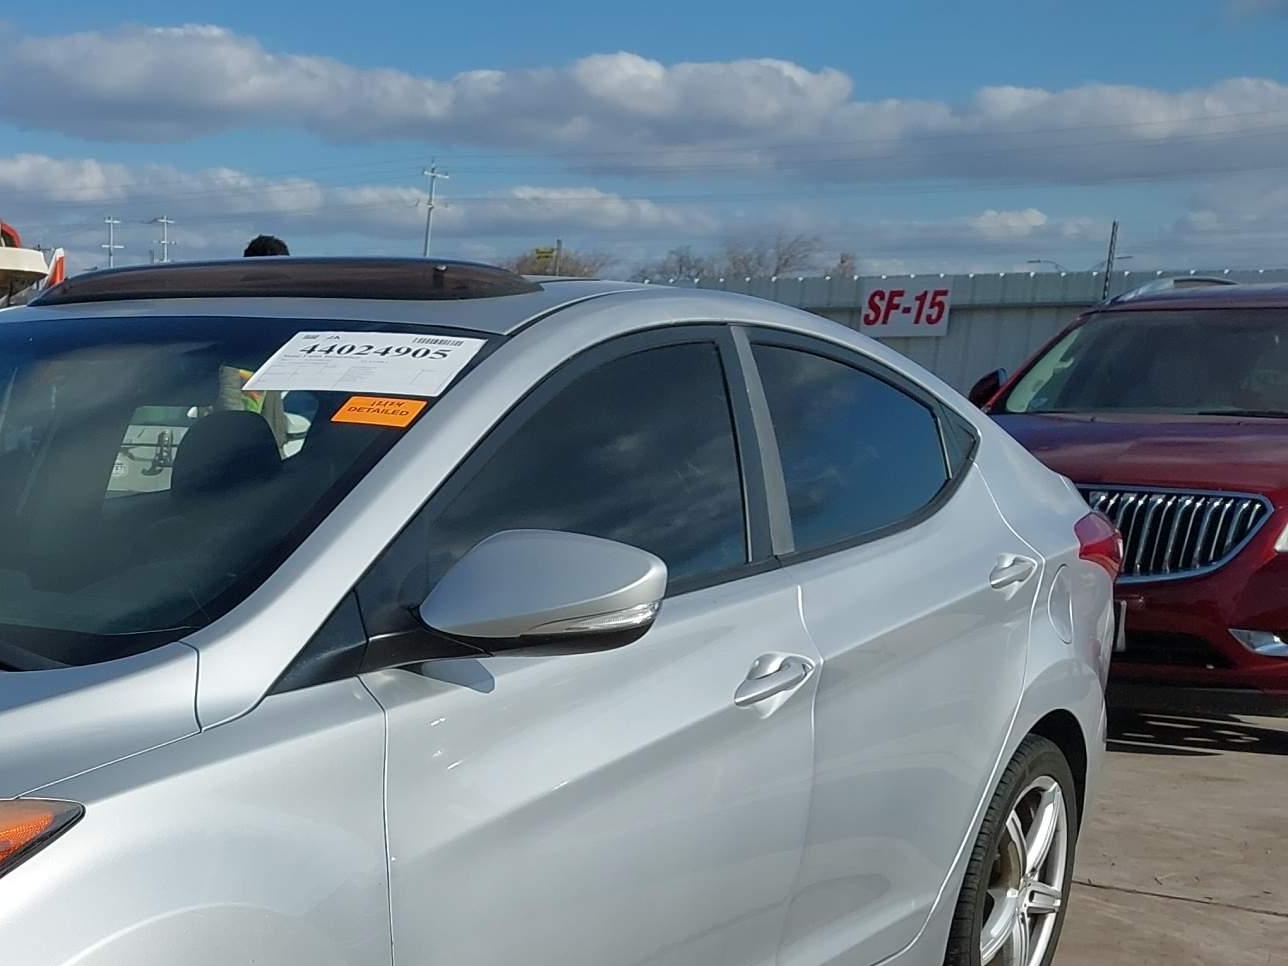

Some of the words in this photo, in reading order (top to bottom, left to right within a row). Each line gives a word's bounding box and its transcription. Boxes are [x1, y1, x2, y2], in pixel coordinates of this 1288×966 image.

[863, 289, 949, 326] SF-15
[299, 343, 454, 360] 44024905
[347, 406, 409, 417] DETAILED
